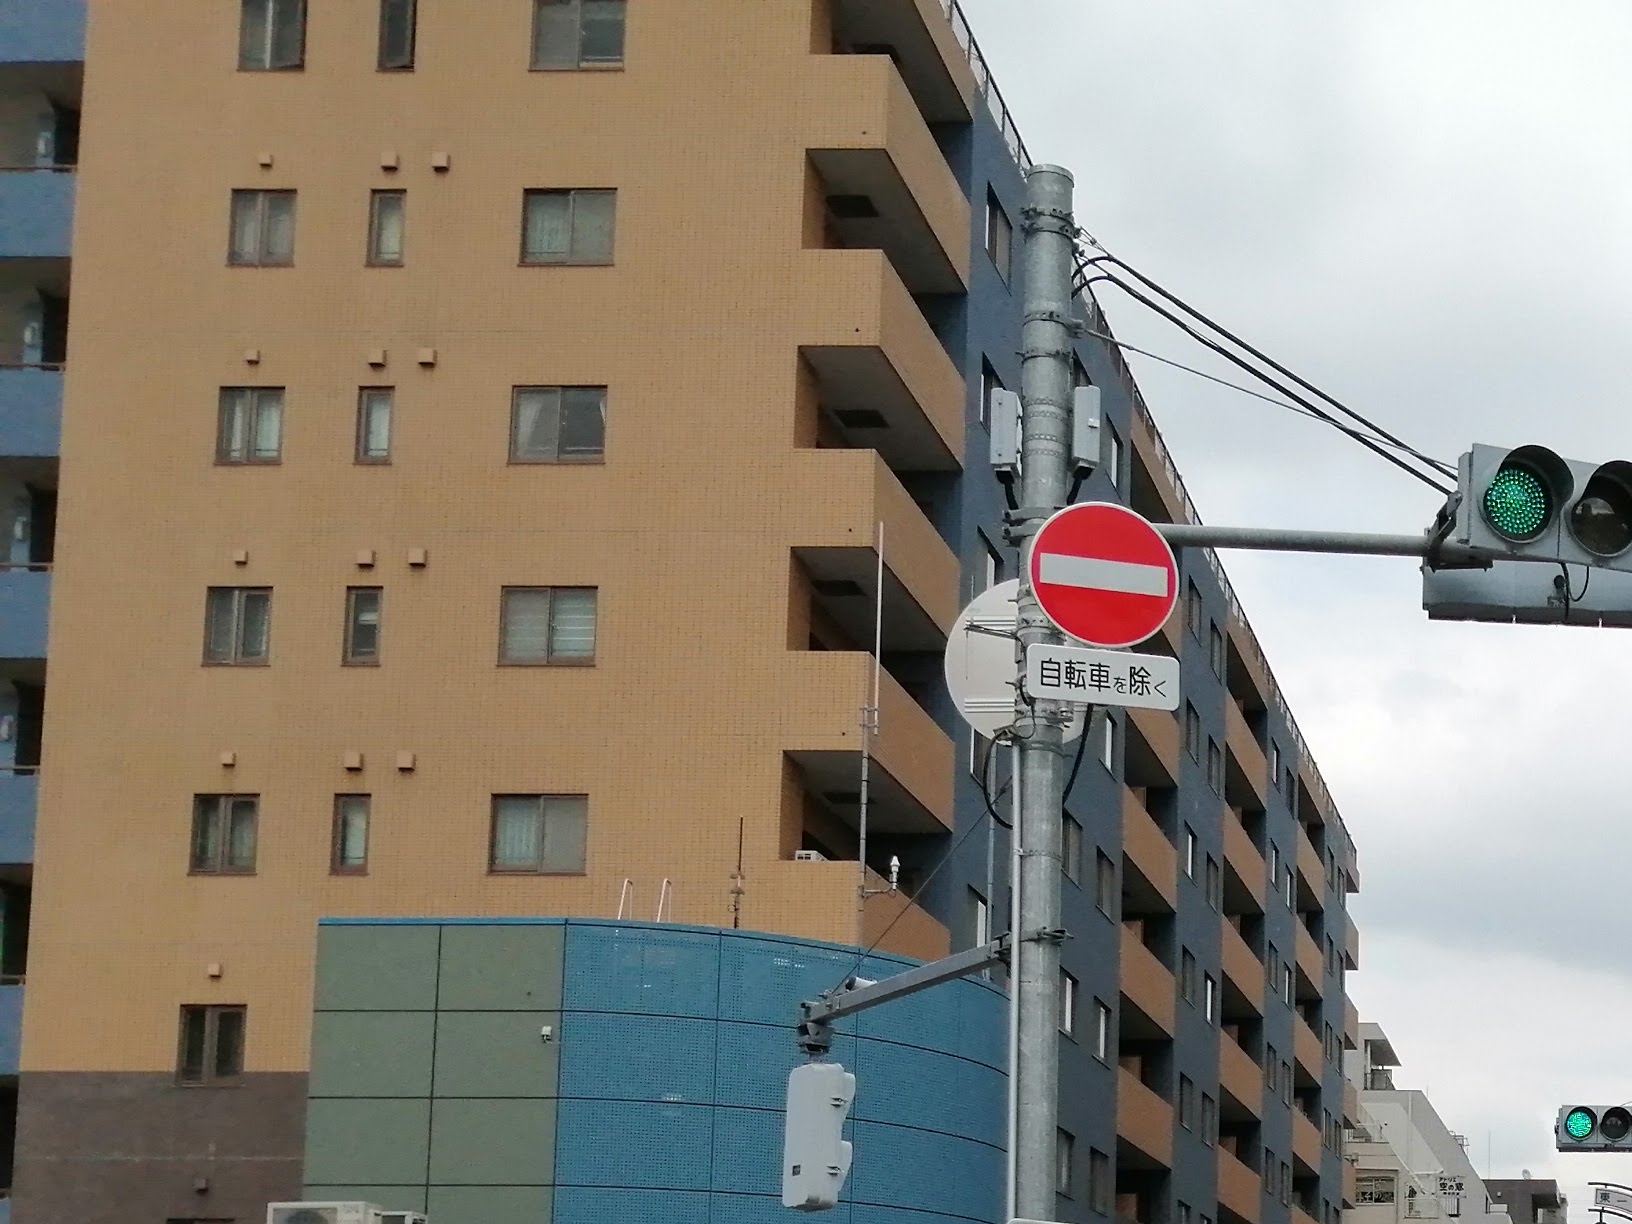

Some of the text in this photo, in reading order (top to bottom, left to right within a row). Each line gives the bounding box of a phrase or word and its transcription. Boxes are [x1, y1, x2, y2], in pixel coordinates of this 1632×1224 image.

[1040, 658, 1167, 698] 自転車を除く
